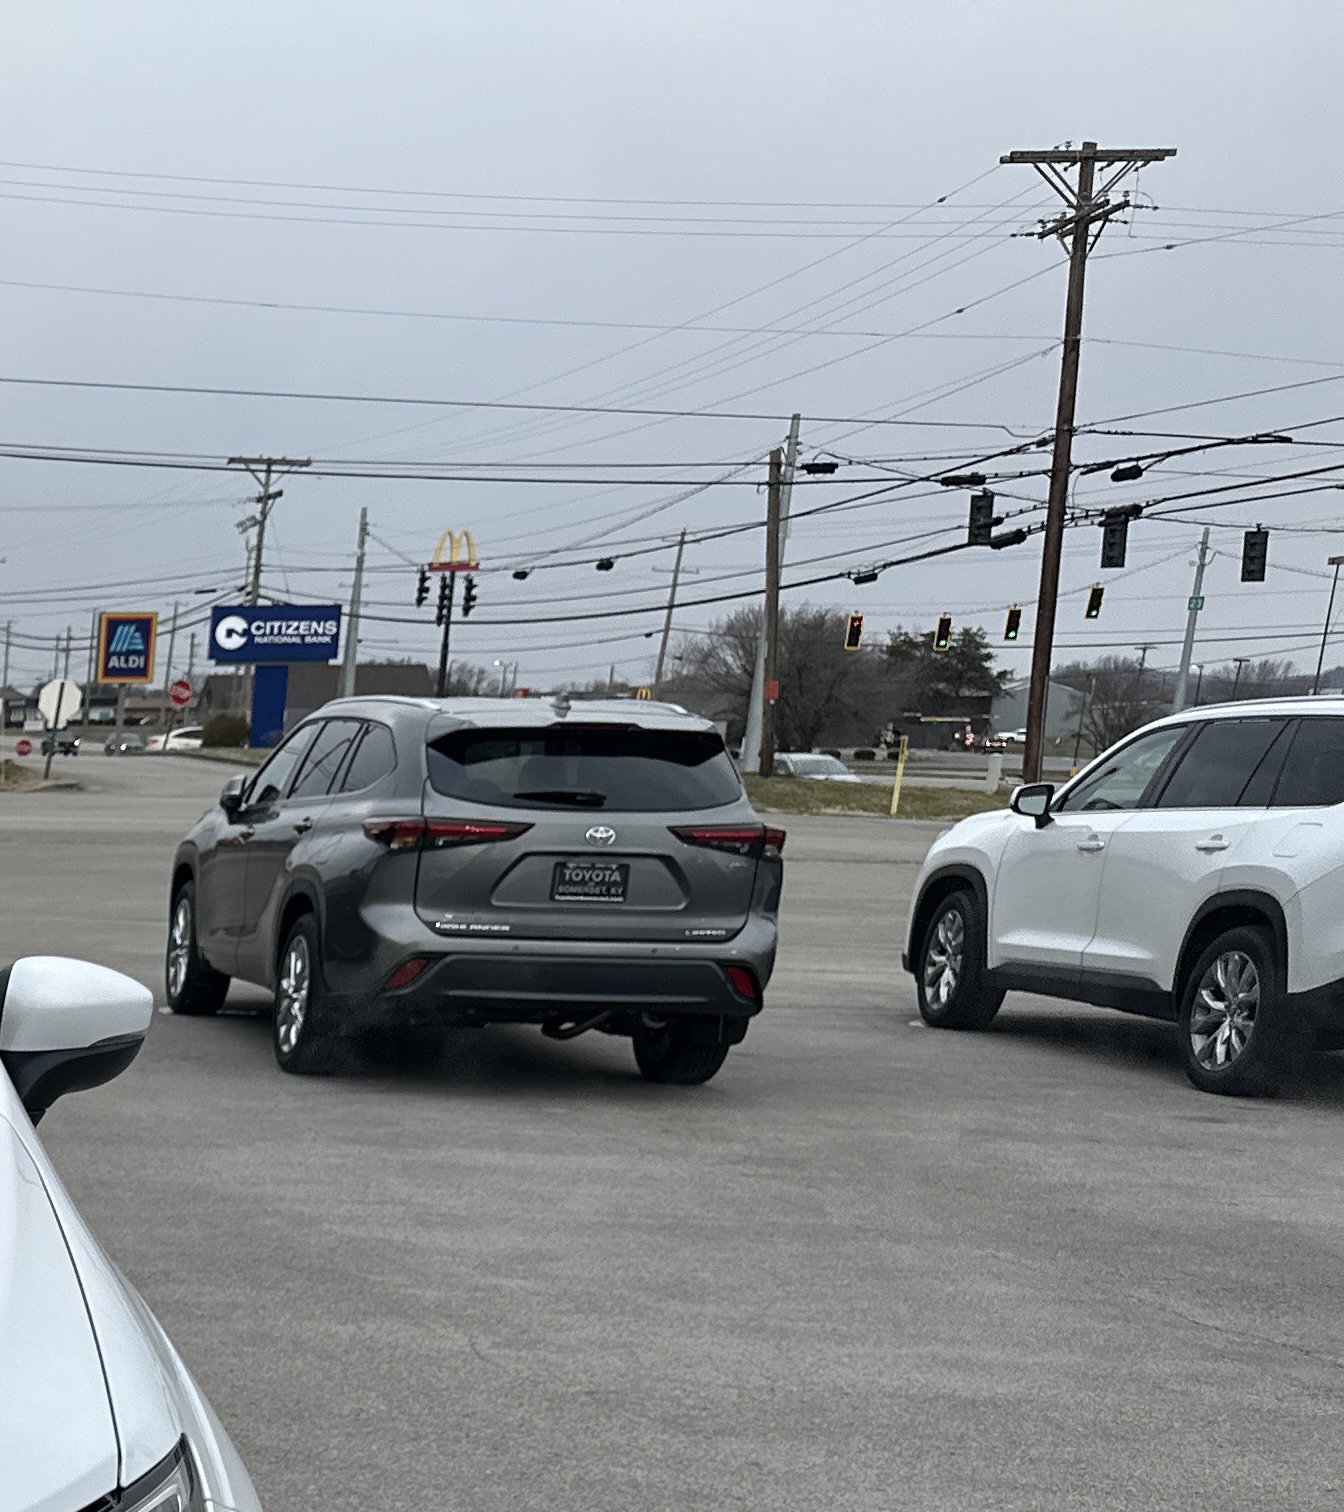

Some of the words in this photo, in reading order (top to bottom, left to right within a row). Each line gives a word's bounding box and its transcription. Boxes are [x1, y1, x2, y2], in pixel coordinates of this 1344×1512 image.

[251, 620, 338, 636] CITIZENS
[254, 635, 302, 644] NATIONAL
[304, 635, 332, 644] BANK
[108, 655, 145, 669] ALDI
[563, 868, 621, 882] TOYOTA
